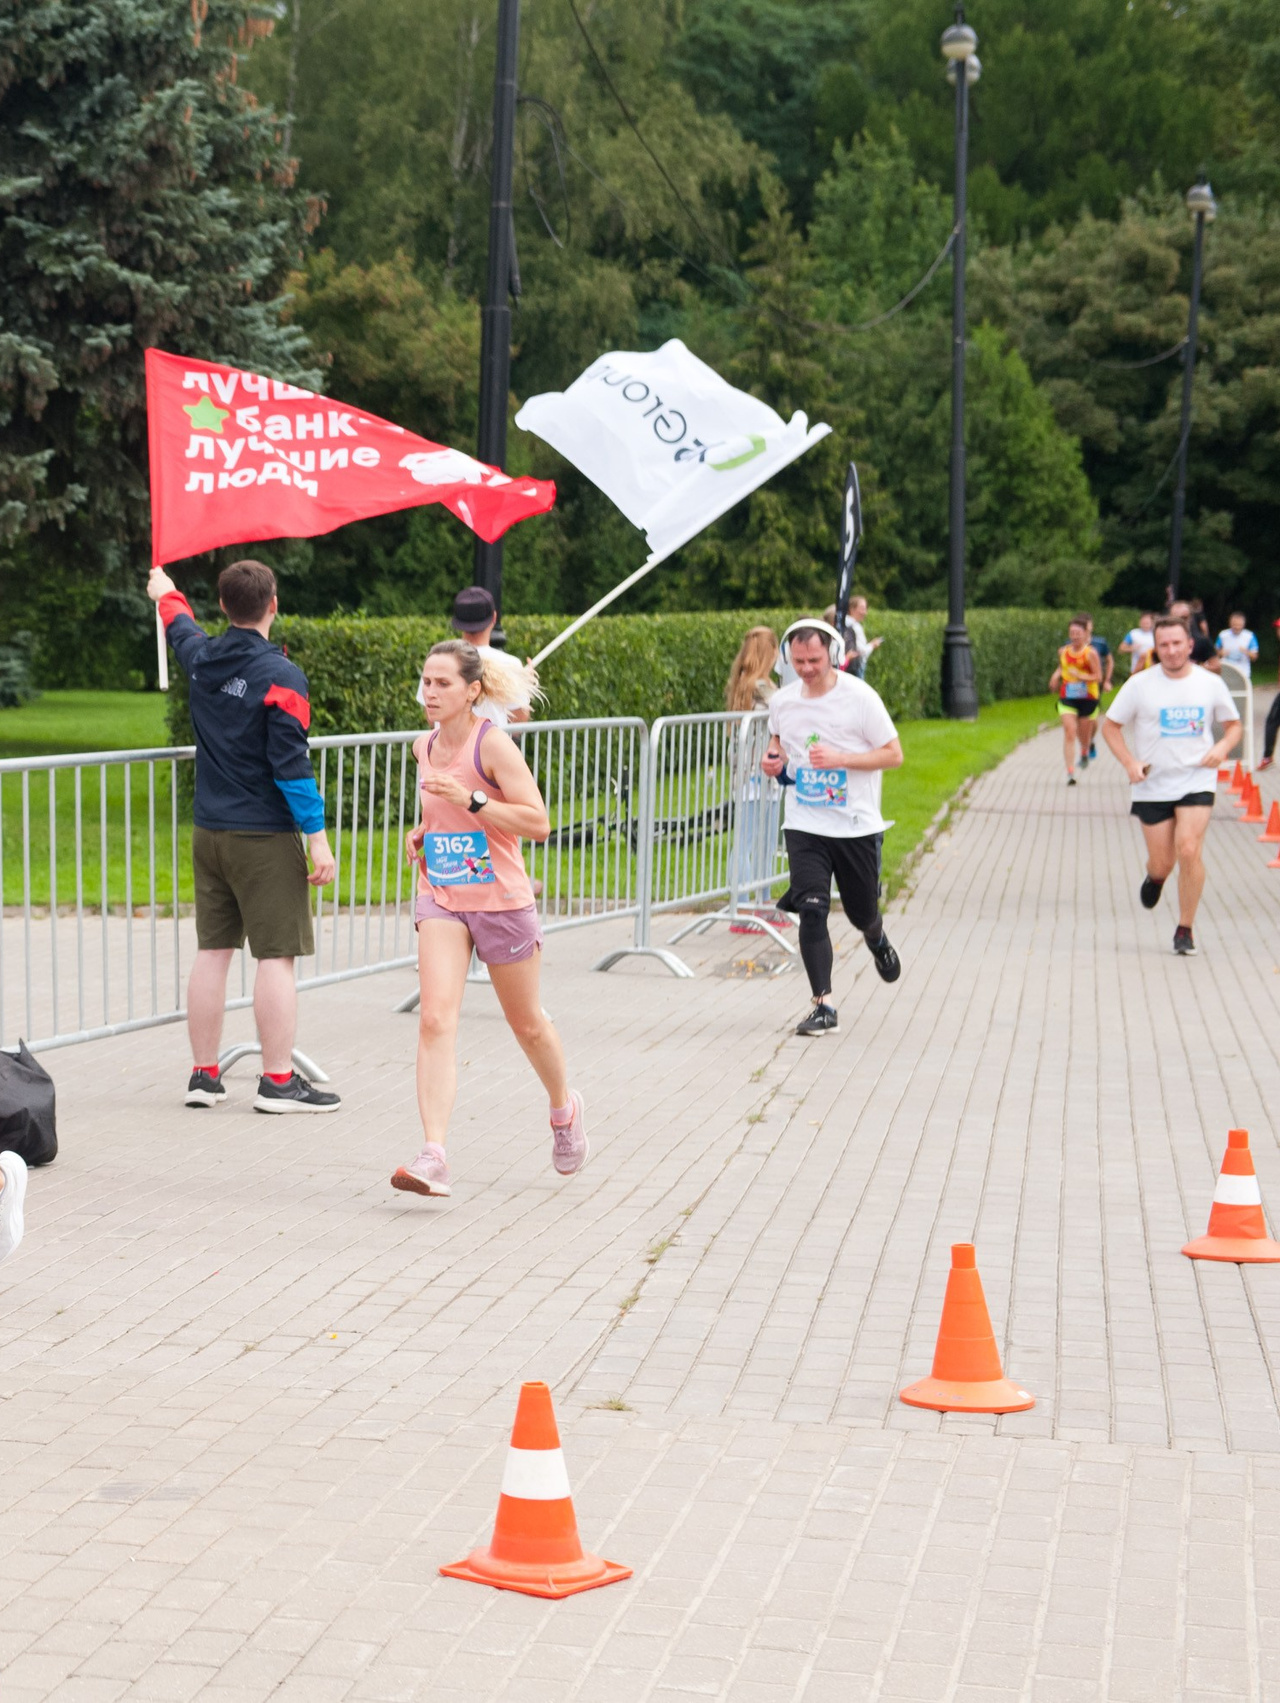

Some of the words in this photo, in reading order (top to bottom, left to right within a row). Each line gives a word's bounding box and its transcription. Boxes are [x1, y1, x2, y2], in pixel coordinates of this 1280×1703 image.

[236, 406, 358, 441] банк
[185, 434, 380, 472] лучшие
[185, 461, 318, 497] люди
[801, 769, 839, 786] 3340
[433, 835, 476, 854] 3162
